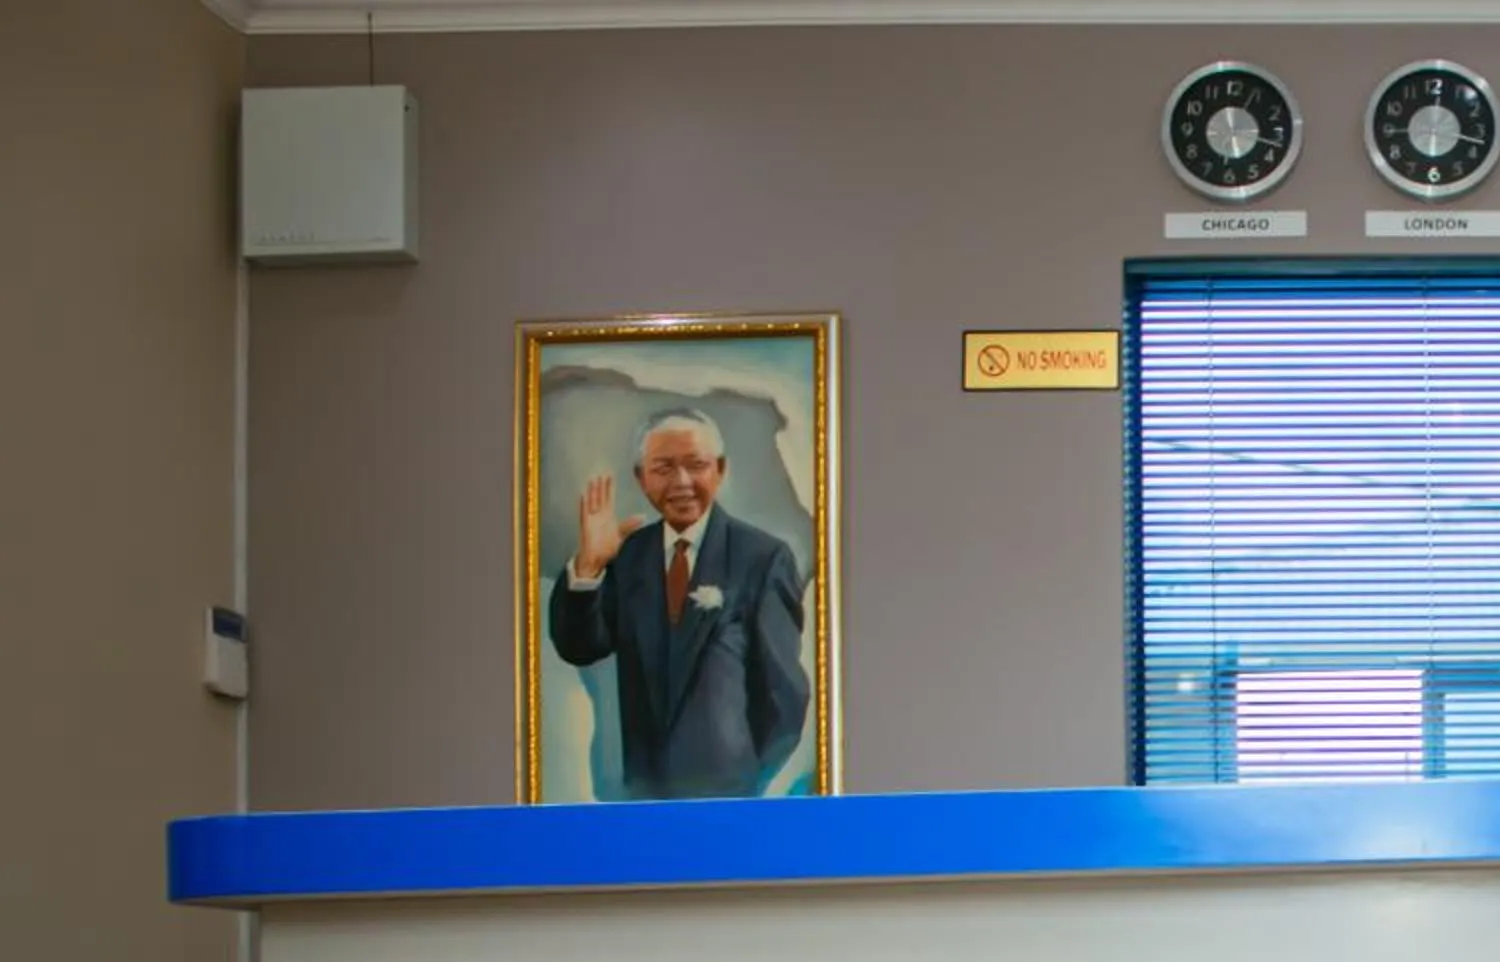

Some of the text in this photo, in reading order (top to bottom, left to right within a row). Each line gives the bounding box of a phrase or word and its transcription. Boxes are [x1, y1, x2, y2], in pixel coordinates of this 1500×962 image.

[1205, 84, 1219, 99] 11
[1227, 80, 1243, 96] 12
[1404, 85, 1416, 100] 11
[1425, 78, 1443, 95] 12
[1187, 100, 1203, 116] 10
[1269, 105, 1281, 121] 2
[1387, 100, 1403, 117] 10
[1470, 102, 1481, 118] 2
[1181, 122, 1193, 137] 9
[1475, 123, 1486, 140] 3
[1186, 143, 1198, 159] 8
[1390, 144, 1401, 160] 8
[1202, 161, 1213, 177] 7
[1223, 168, 1235, 184] 6
[1248, 164, 1259, 179] 5
[1428, 166, 1441, 183] 6
[1453, 161, 1463, 176] 5
[1201, 218, 1270, 231] CHICAGO
[1404, 217, 1468, 231] LONDON
[1017, 350, 1107, 371] NO SMOKING
